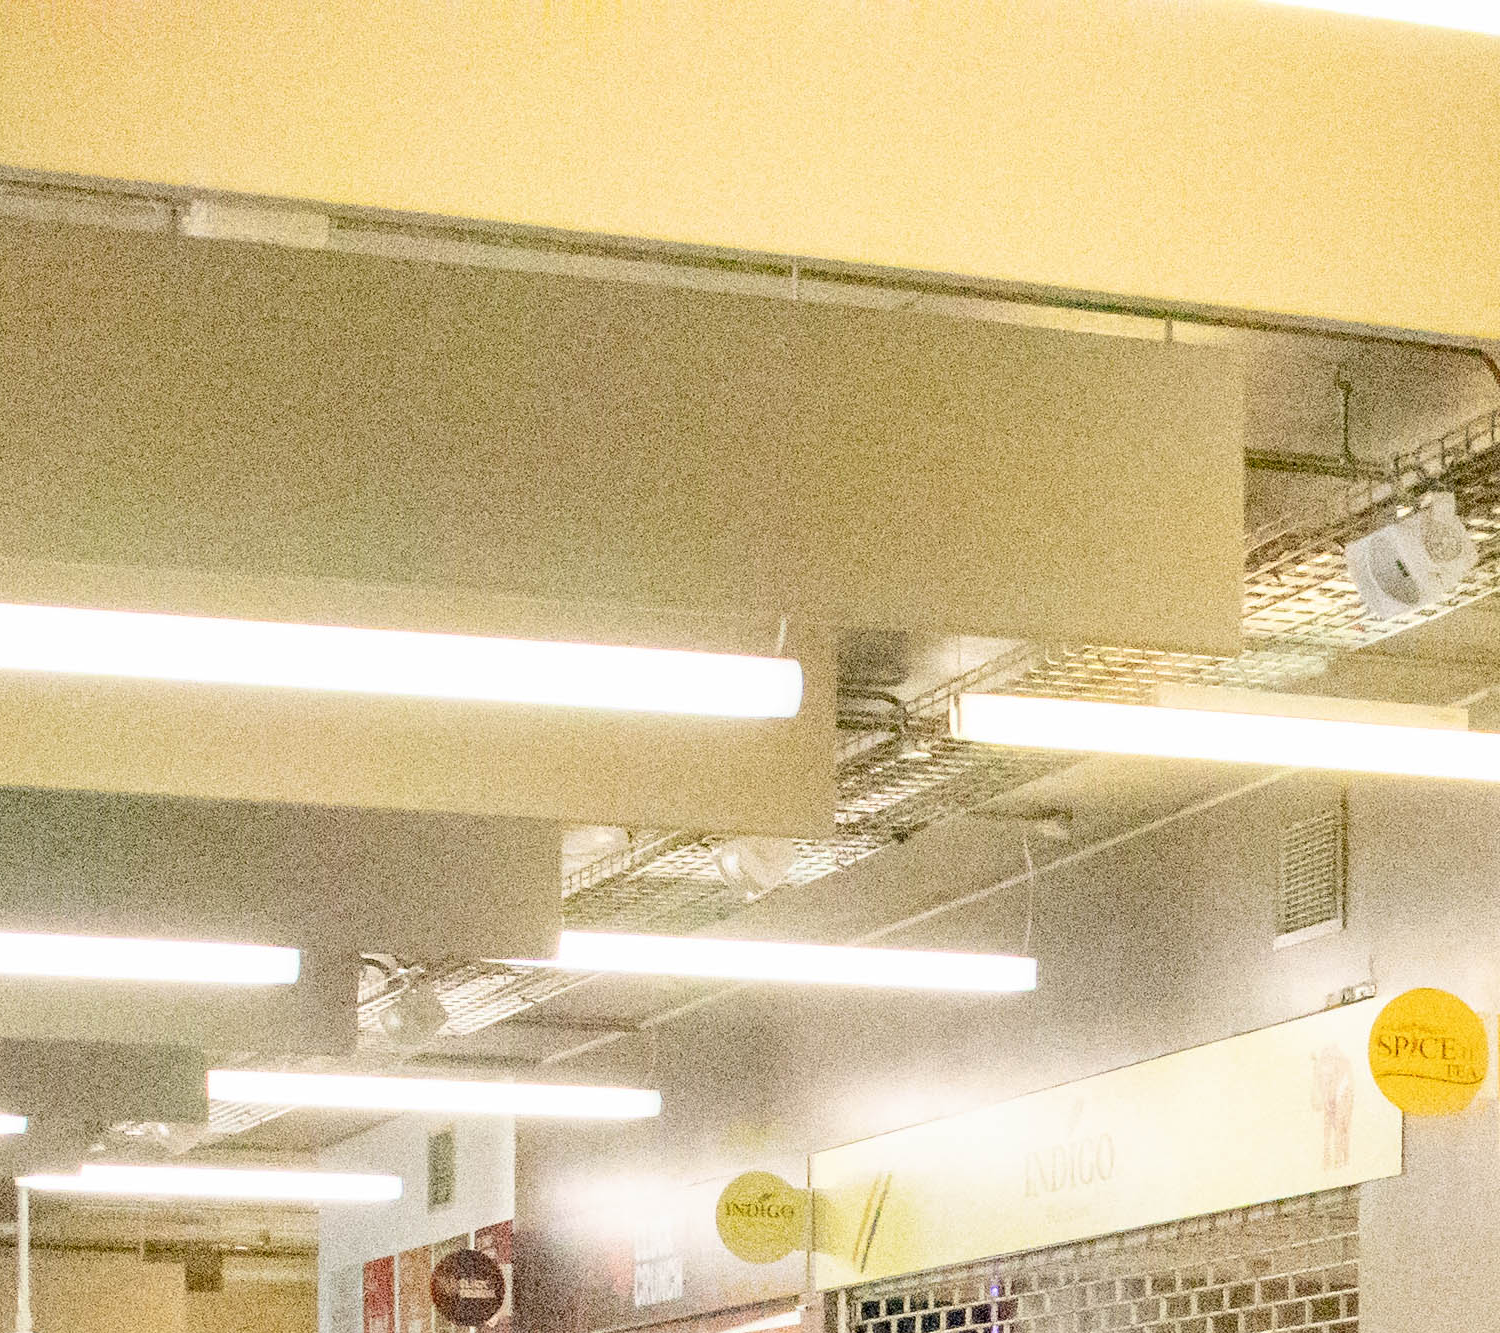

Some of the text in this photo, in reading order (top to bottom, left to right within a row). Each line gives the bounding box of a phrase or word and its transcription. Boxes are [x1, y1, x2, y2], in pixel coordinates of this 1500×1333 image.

[1375, 1034, 1458, 1061] SPICE
[1445, 1063, 1480, 1080] TEA
[724, 1201, 796, 1220] INDIGO
